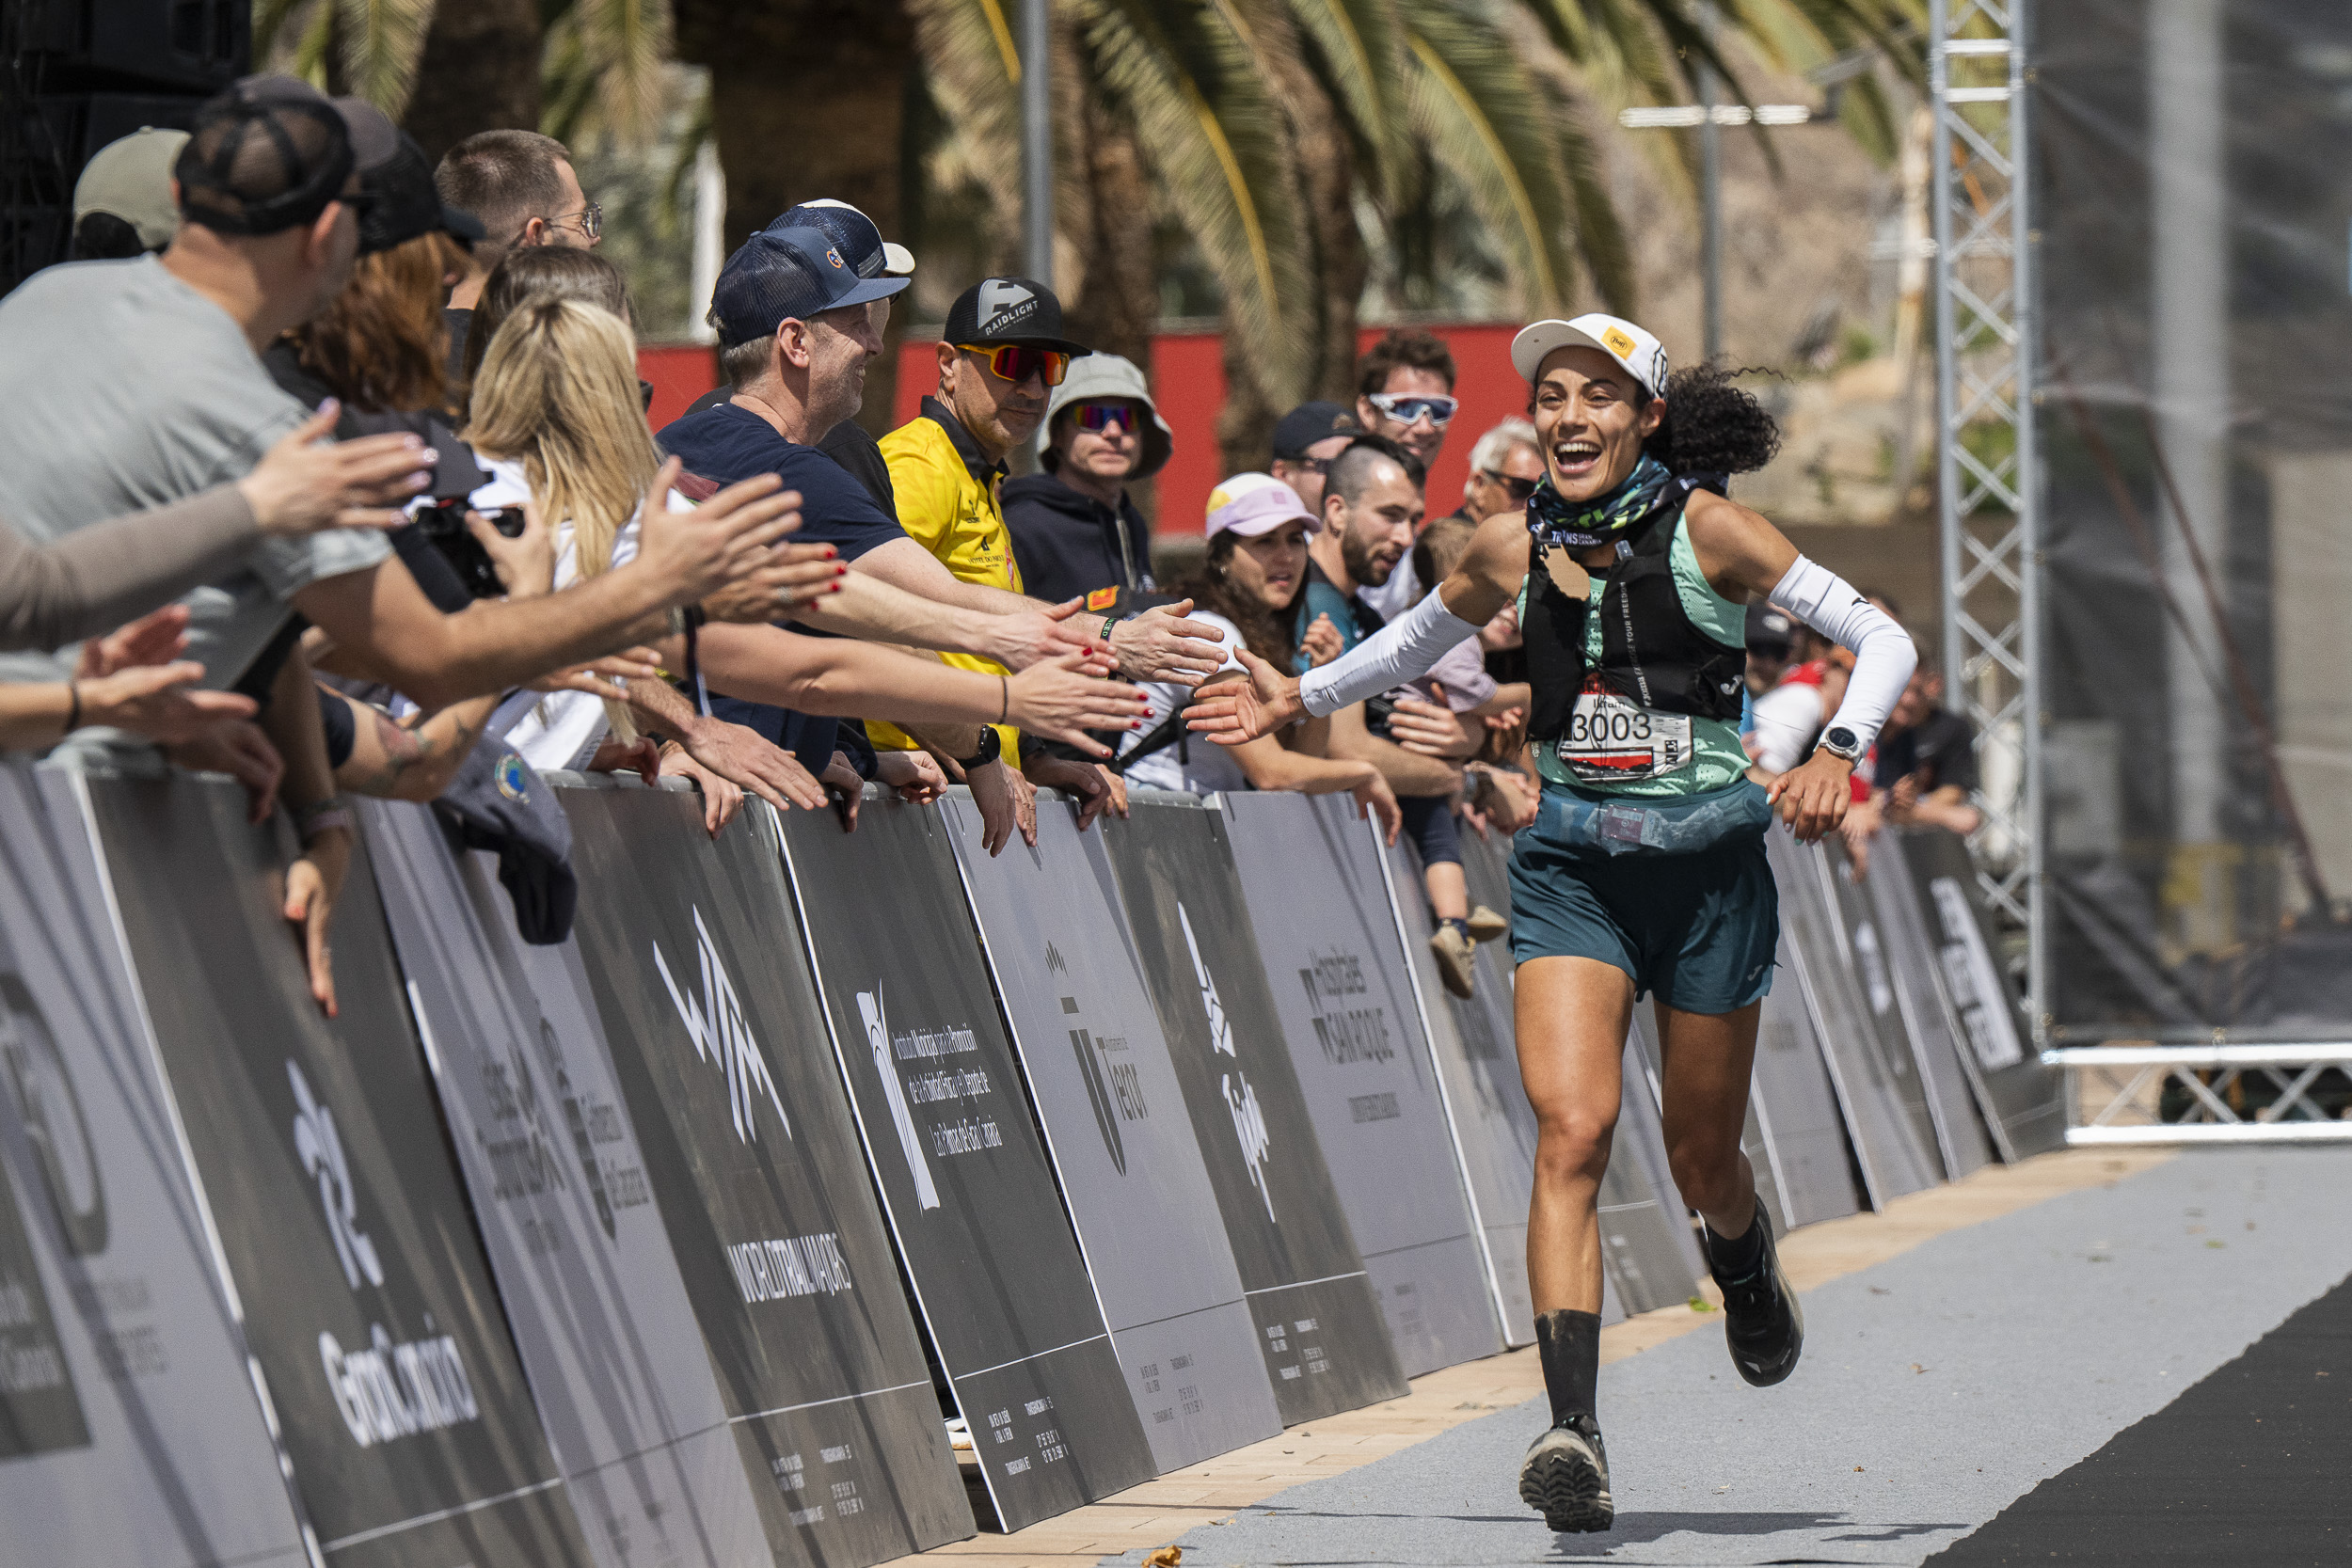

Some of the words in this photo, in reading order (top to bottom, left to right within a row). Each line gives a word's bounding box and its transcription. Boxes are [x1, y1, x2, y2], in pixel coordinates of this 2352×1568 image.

[985, 300, 1038, 336] RAIDLIGHT
[1625, 621, 1634, 642] YOUR
[1573, 712, 1652, 742] 3003
[911, 1028, 939, 1064] Municipal
[947, 1022, 977, 1053] Promoción
[909, 1076, 920, 1104] de
[914, 1075, 926, 1102] la
[958, 1069, 966, 1096] el
[960, 1069, 984, 1102] Deporte
[979, 1066, 991, 1093] de
[1096, 1037, 1149, 1121] Teror
[929, 1125, 946, 1156] Las
[938, 1122, 963, 1154] Palmas
[958, 1120, 971, 1151] de
[963, 1118, 983, 1150] Gran
[977, 1115, 1003, 1148] Canaria
